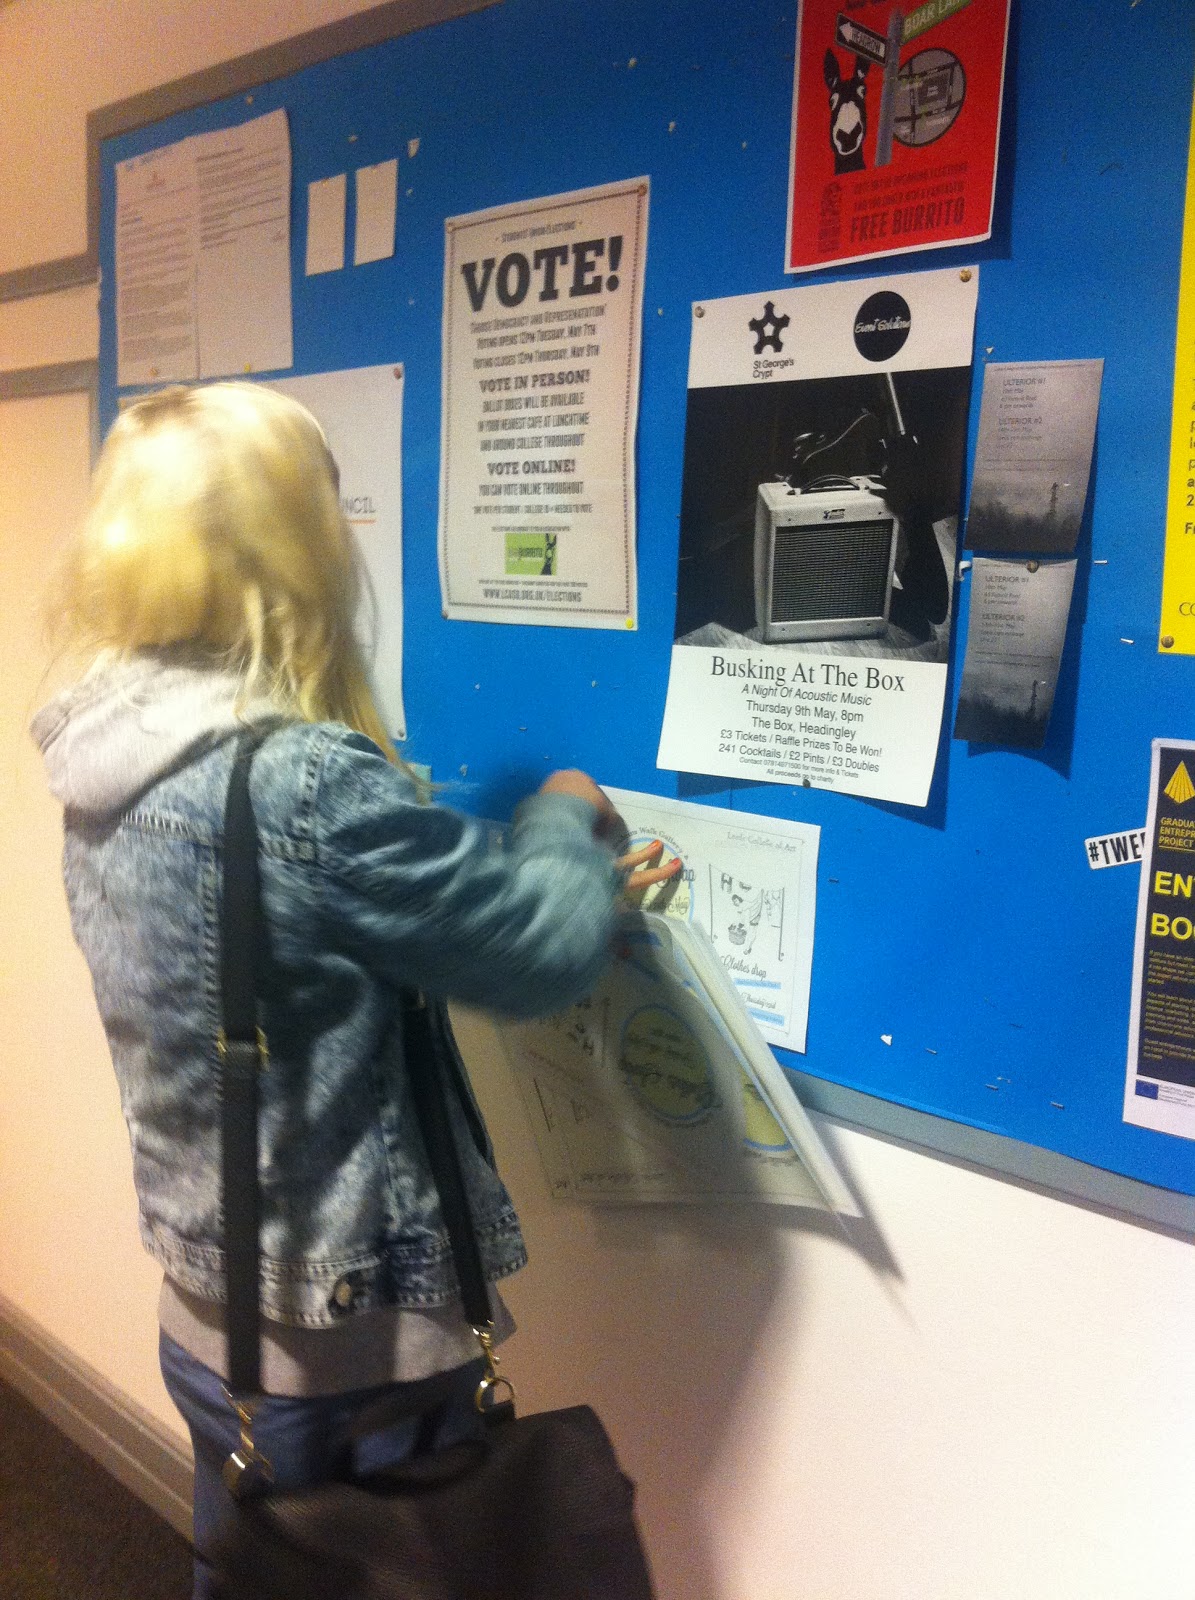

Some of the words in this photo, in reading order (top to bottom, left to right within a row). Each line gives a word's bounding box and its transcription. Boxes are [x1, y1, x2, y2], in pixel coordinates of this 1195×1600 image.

[904, 3, 936, 36] BOAR
[938, 0, 960, 14] LA
[850, 211, 890, 243] FREE
[892, 196, 965, 235] BURRITO
[460, 235, 624, 313] VOTE!
[753, 360, 761, 369] St
[762, 358, 795, 369] George's
[478, 376, 512, 394] VOTE
[514, 374, 529, 390] IN
[531, 369, 591, 387] PERSON!
[753, 369, 773, 380] Crypt
[1003, 377, 1036, 387] ULTERIOR
[524, 395, 539, 409] WILL
[540, 394, 548, 408] BE
[550, 391, 585, 407] AVAILABLE
[552, 411, 590, 427] LUNCHTIME
[998, 417, 1032, 426] ULTERIOR
[516, 436, 542, 450] COLLEGE
[544, 433, 585, 448] THROUGHOUT
[486, 461, 519, 476] VOTE
[521, 458, 576, 475] ONLINE!
[519, 482, 541, 495] ONLINE
[542, 481, 584, 494] THROUGHOUT
[343, 496, 377, 514] NCIL
[985, 575, 1020, 583] ULTERIOR
[711, 655, 787, 686] Busking
[791, 662, 815, 684] At
[821, 663, 859, 687] The
[865, 666, 905, 692] Box
[741, 684, 750, 694] A
[751, 684, 778, 701] Night
[780, 686, 793, 698] Of
[794, 688, 839, 704] Acoustic
[840, 692, 873, 706] Music
[746, 700, 792, 717] Thursday
[794, 704, 811, 717] 9th
[813, 706, 838, 722] May,
[840, 710, 865, 723] 8pm
[752, 716, 771, 729] The
[773, 718, 796, 733] Box,
[799, 721, 857, 741] Headingley
[720, 729, 733, 739] £3
[735, 730, 767, 743] Tickets
[774, 735, 801, 747] Raffle
[802, 738, 830, 751] Prizes
[832, 741, 844, 753] To
[845, 743, 858, 754] Be
[859, 745, 883, 758] Won!
[718, 743, 736, 753] 241
[739, 745, 781, 759] Cocktails
[789, 750, 801, 761] £2
[803, 752, 825, 764] Pints
[832, 756, 844, 767] £3
[845, 757, 880, 773] Doubles
[739, 757, 763, 765] Contact
[811, 765, 824, 773] more
[774, 770, 802, 779] proceeds
[1161, 816, 1195, 828] GRADUA
[1159, 836, 1194, 848] PROJECT
[1154, 870, 1195, 898] EN
[1151, 912, 1195, 941] BO
[721, 955, 751, 974] Clothes
[751, 963, 767, 982] drop
